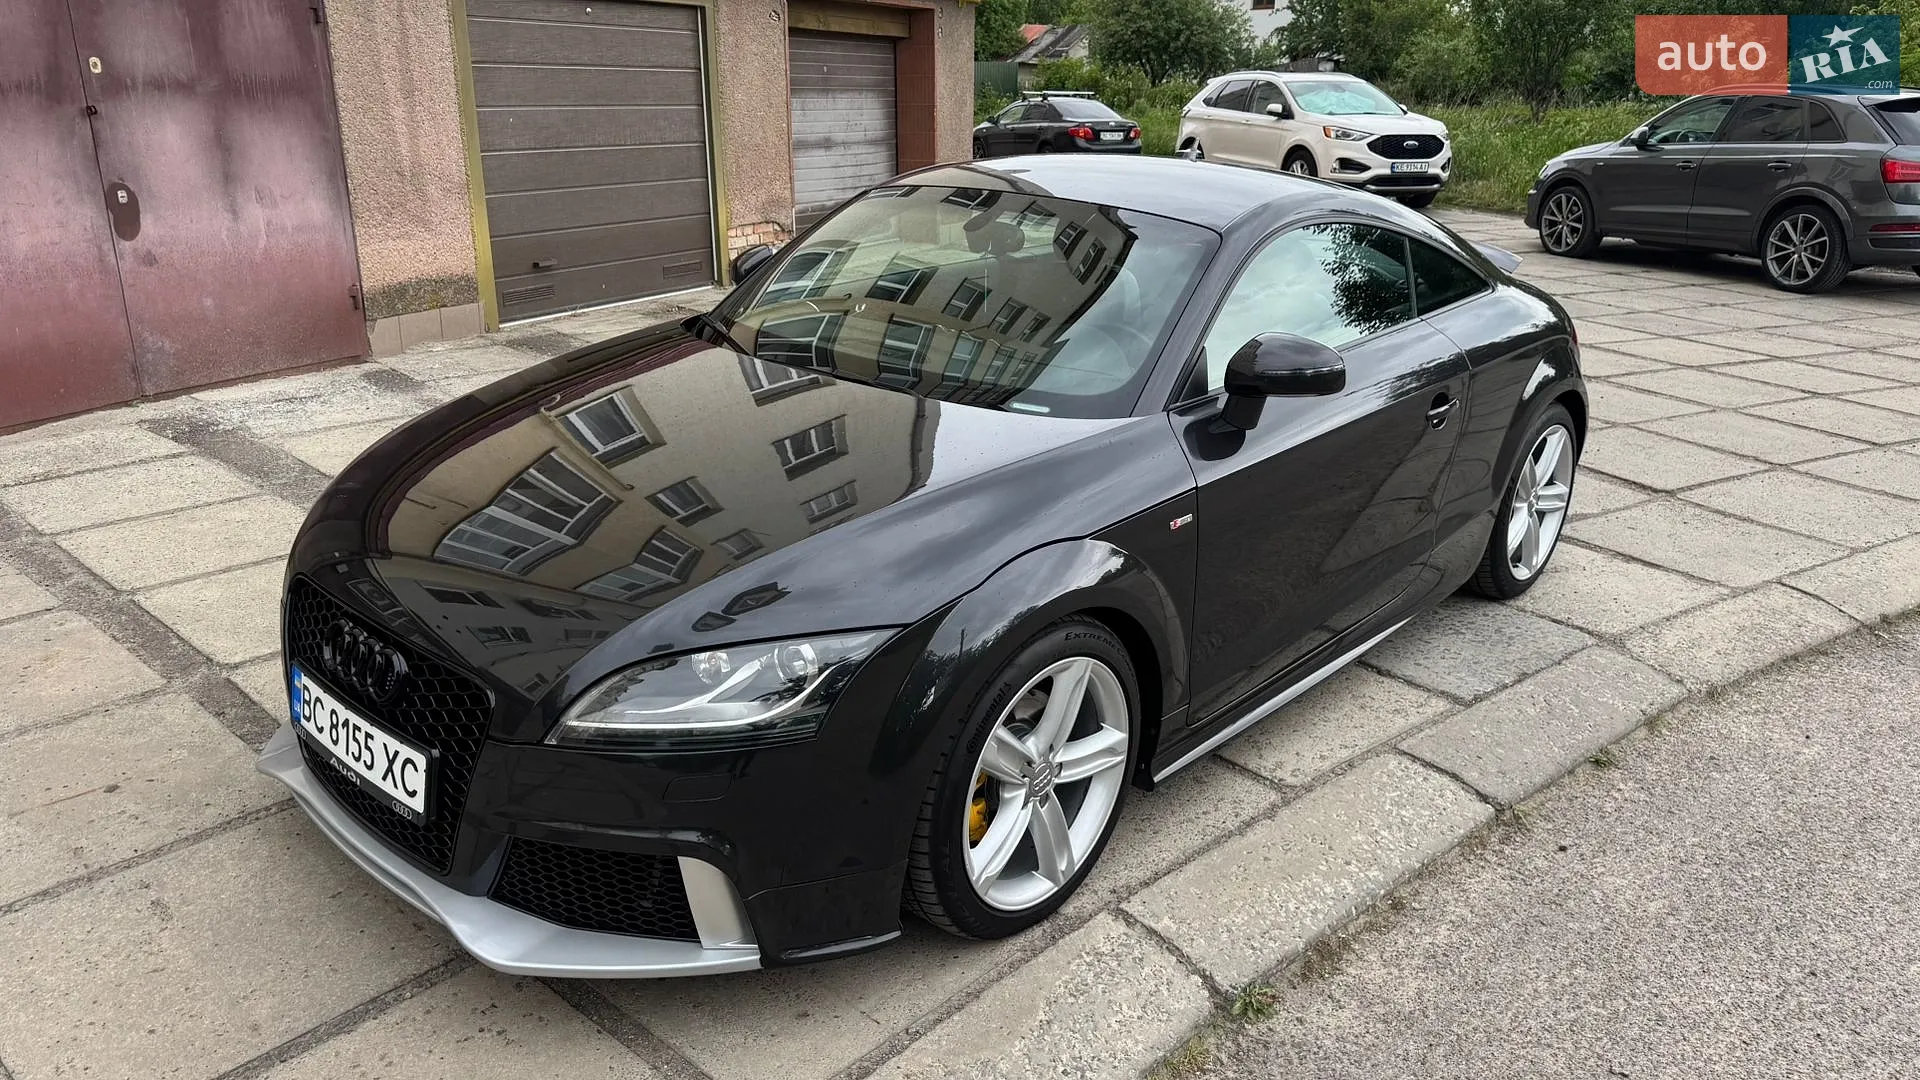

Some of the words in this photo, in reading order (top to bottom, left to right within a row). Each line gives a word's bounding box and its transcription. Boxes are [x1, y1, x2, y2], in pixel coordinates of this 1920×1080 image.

[302, 682, 325, 734] BC
[329, 708, 375, 771] 8155
[381, 742, 418, 799] XC
